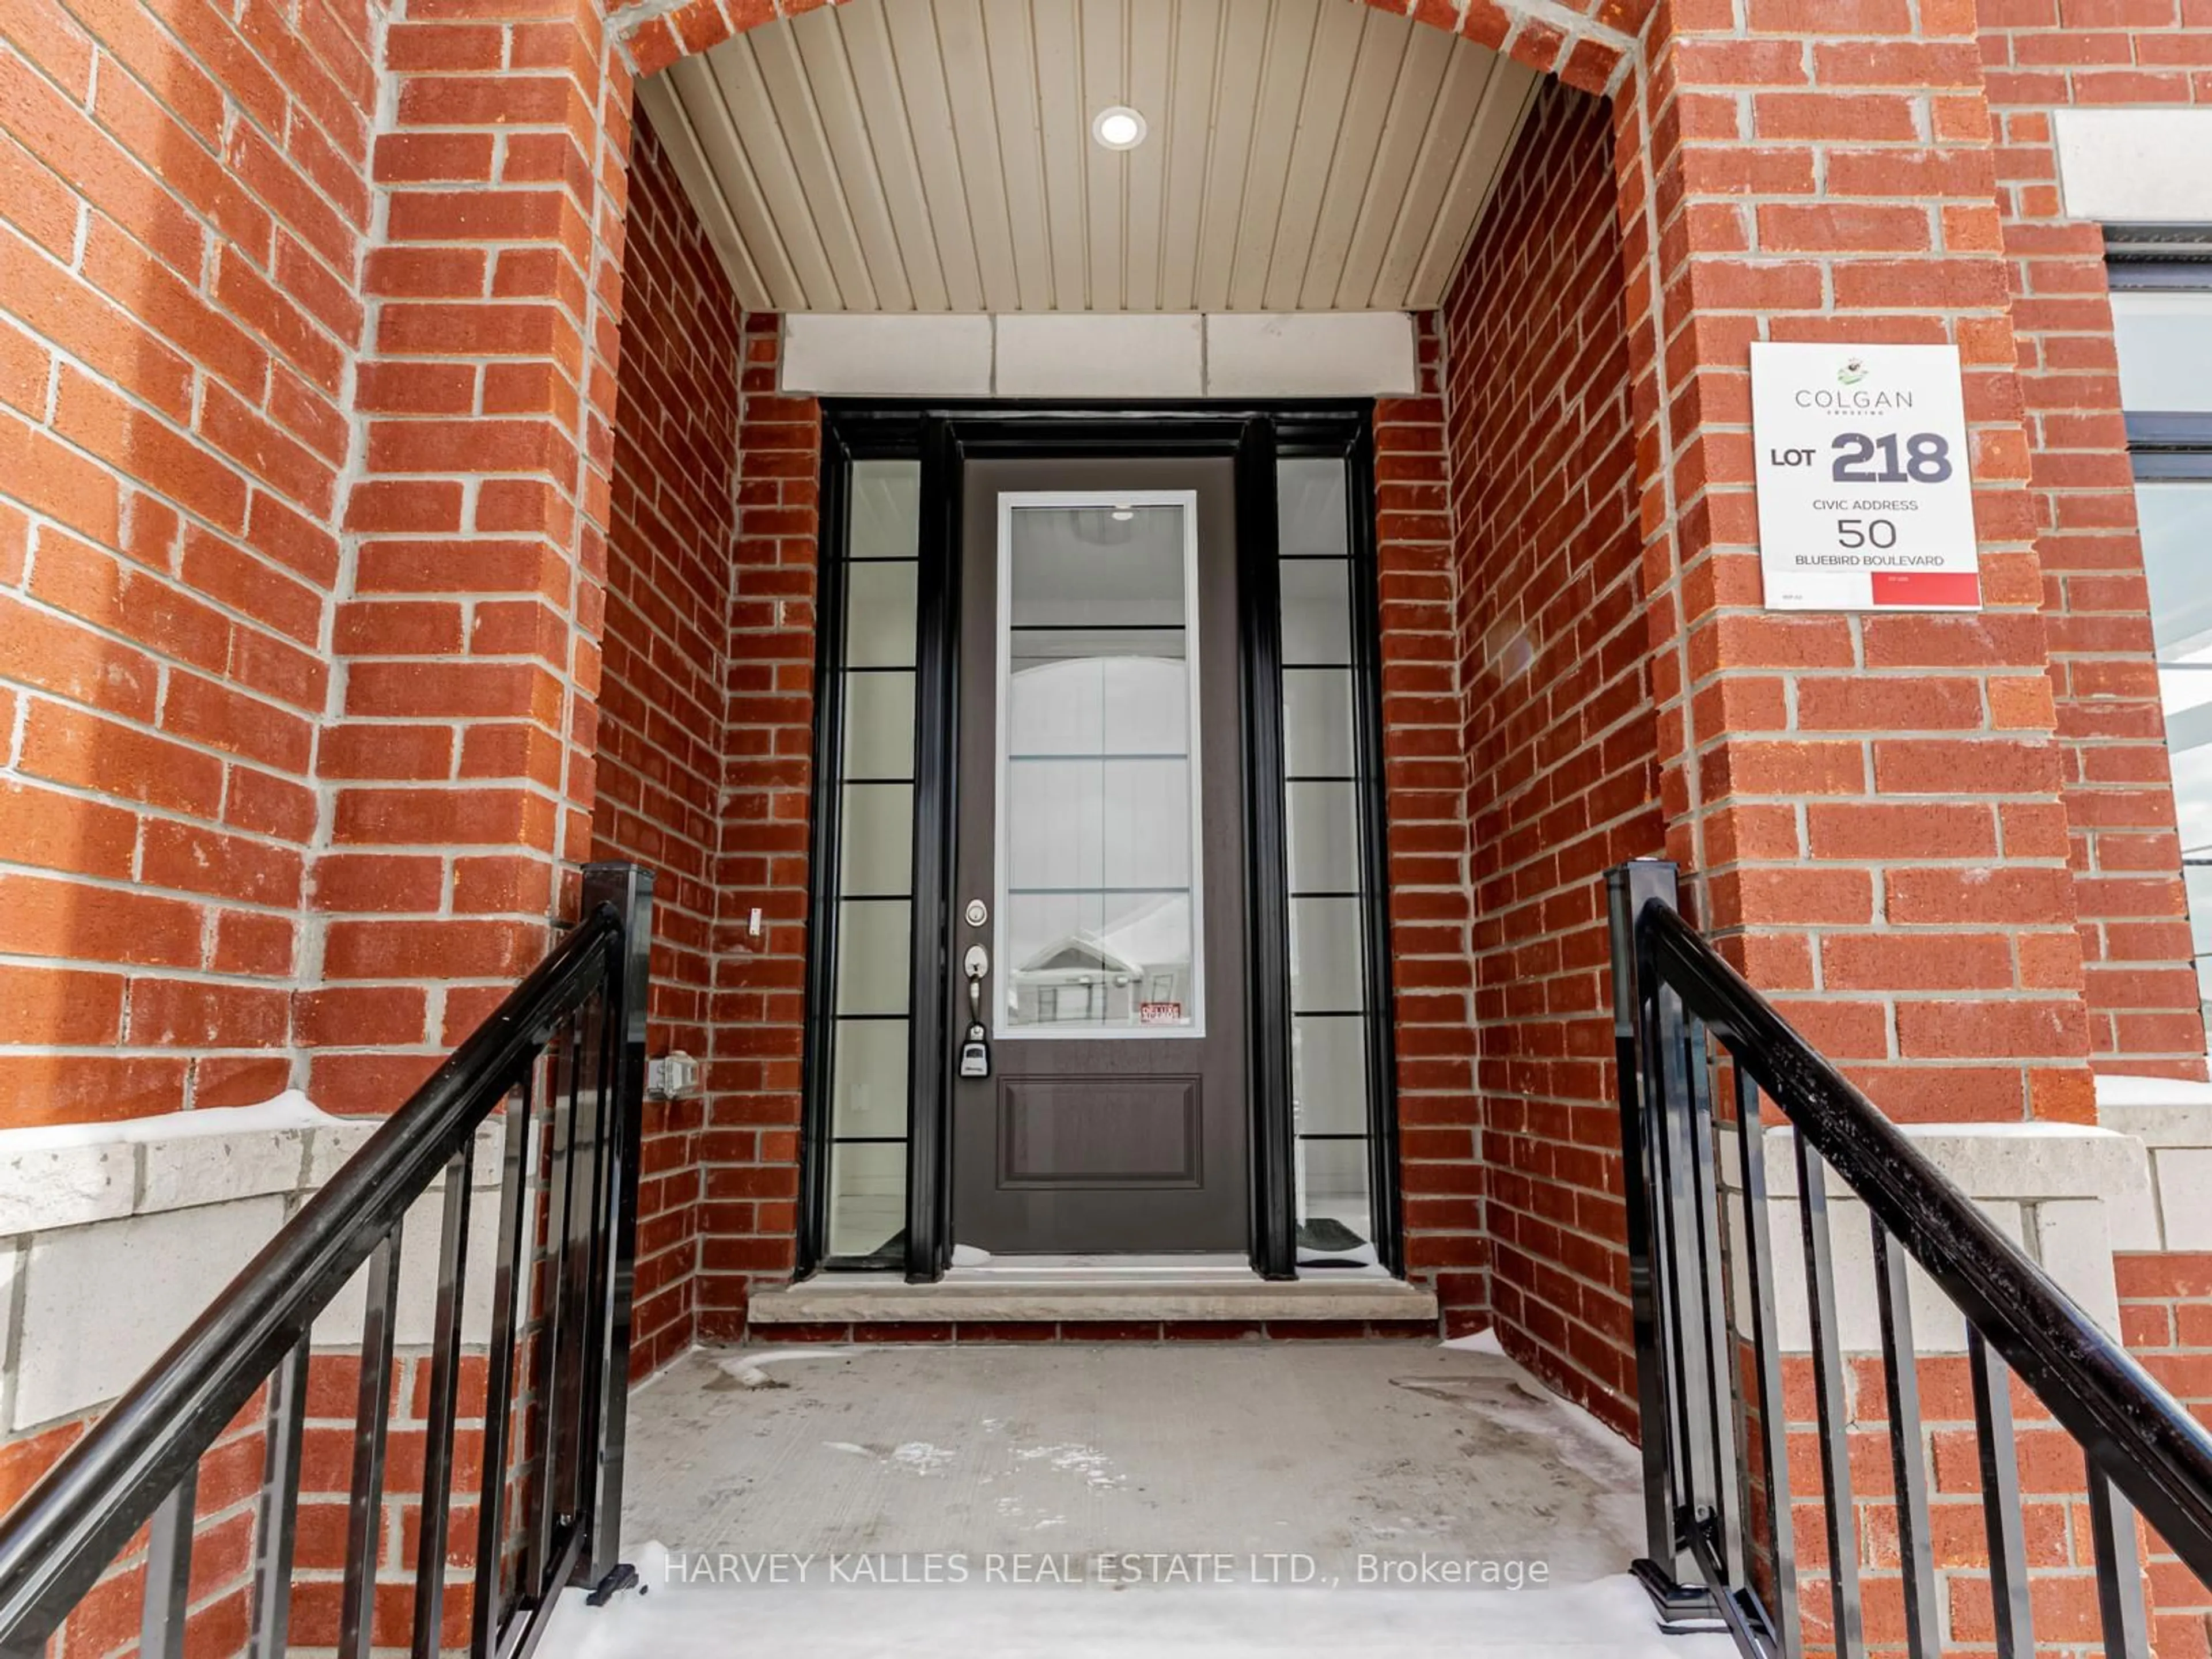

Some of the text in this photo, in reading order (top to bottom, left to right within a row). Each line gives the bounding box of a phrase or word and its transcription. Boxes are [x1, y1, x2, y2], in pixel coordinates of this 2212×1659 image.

[1795, 389, 1913, 408] COLGAN
[1771, 432, 1953, 484] LOT 218
[1812, 499, 1919, 512] CIVIC ADDRESS
[1837, 519, 1897, 549] 50
[1795, 554, 1945, 567] BLUEBIRD BOULEVARD
